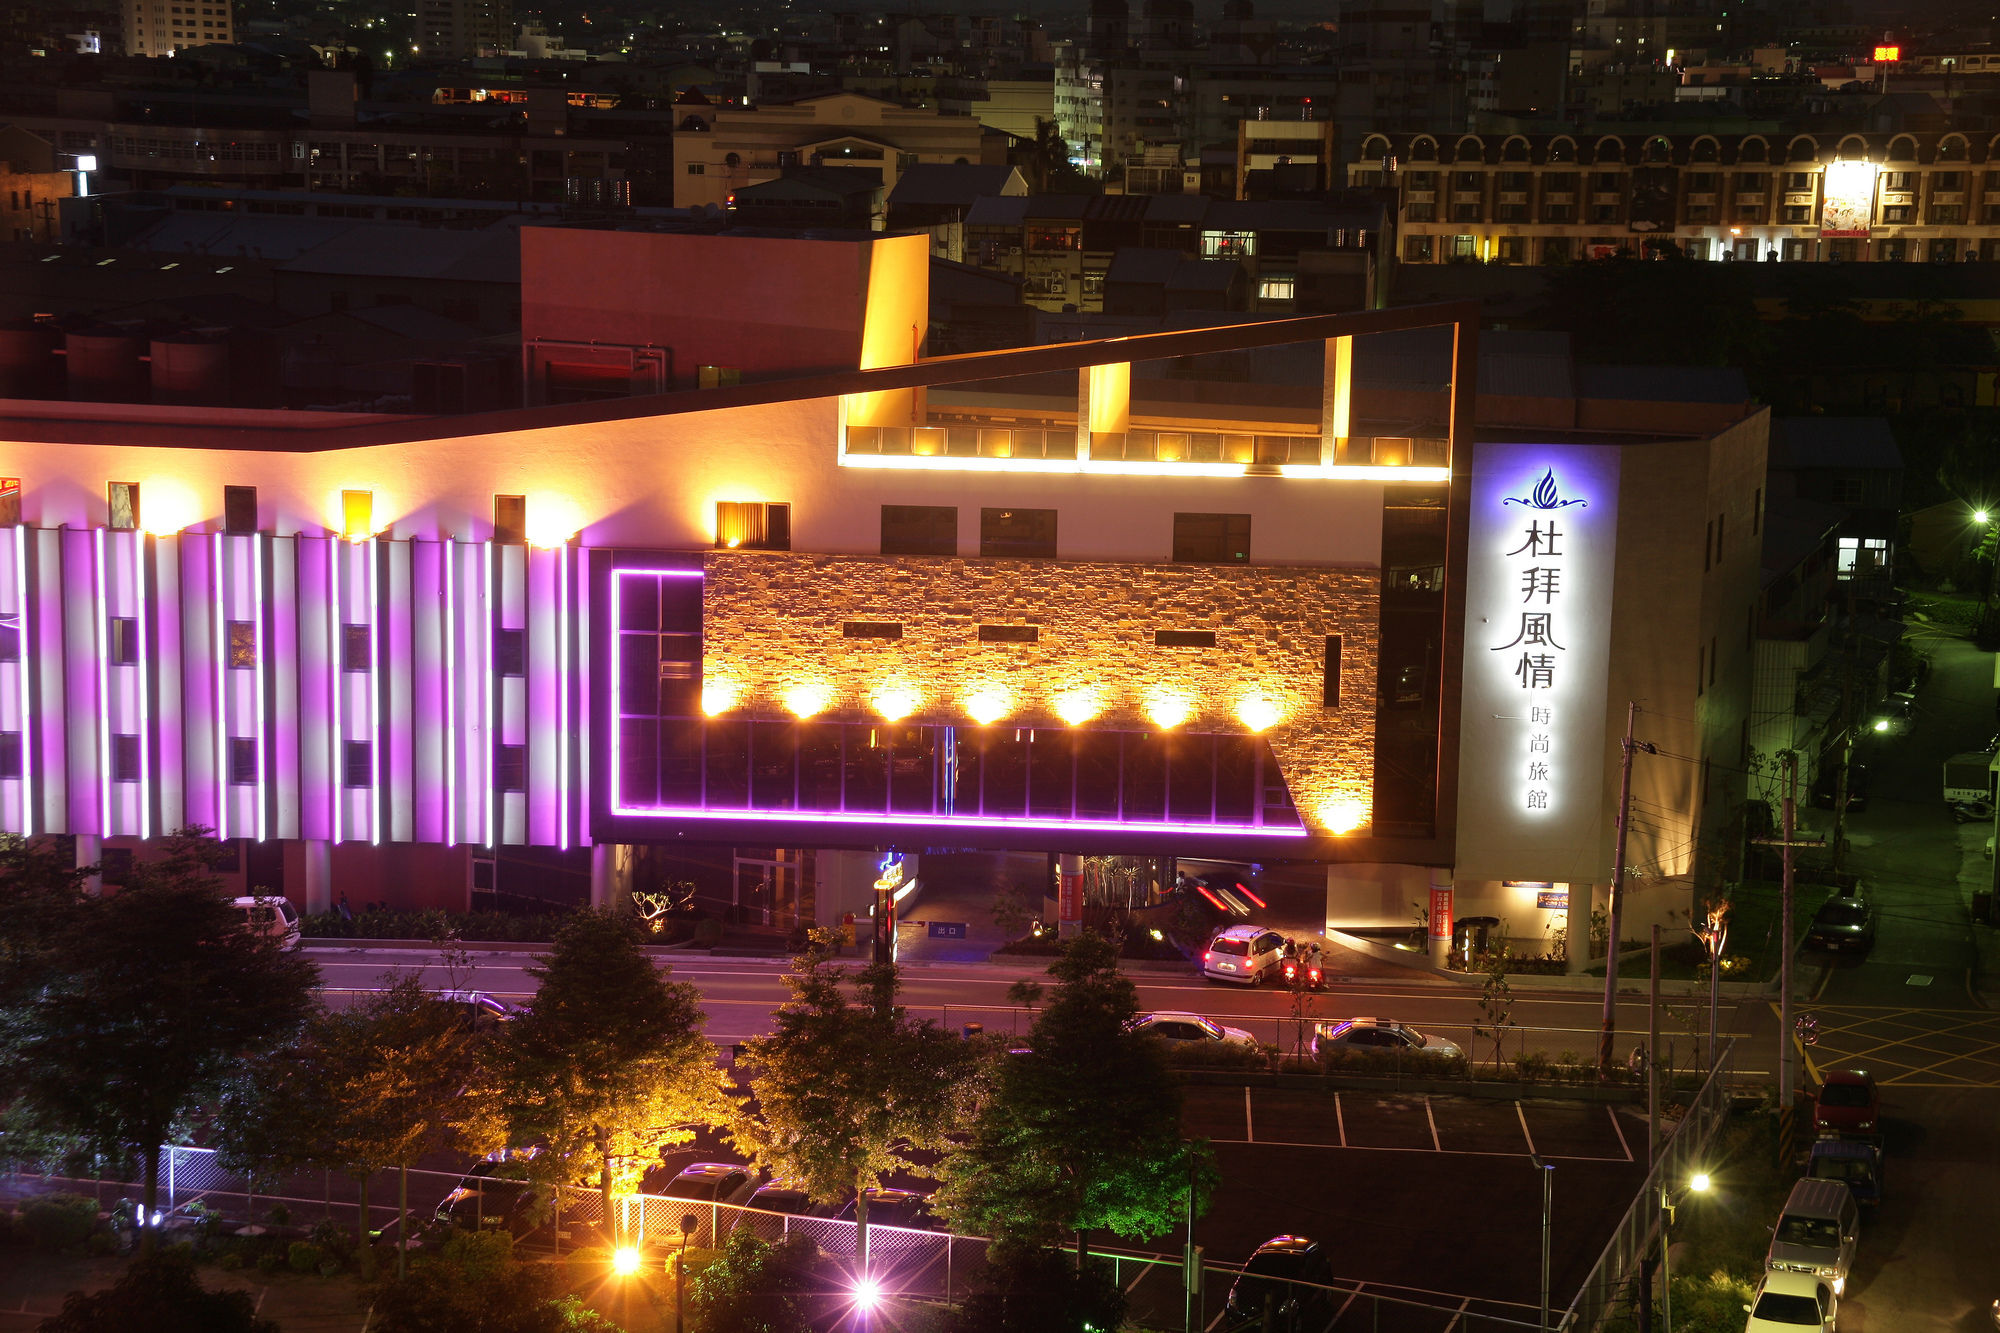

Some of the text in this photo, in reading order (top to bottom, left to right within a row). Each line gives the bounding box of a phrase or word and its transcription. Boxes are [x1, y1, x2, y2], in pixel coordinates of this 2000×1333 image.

[1490, 519, 1566, 689] 杜拜風情
[1528, 707, 1551, 808] 時尚旅館
[937, 926, 956, 935] 出口
